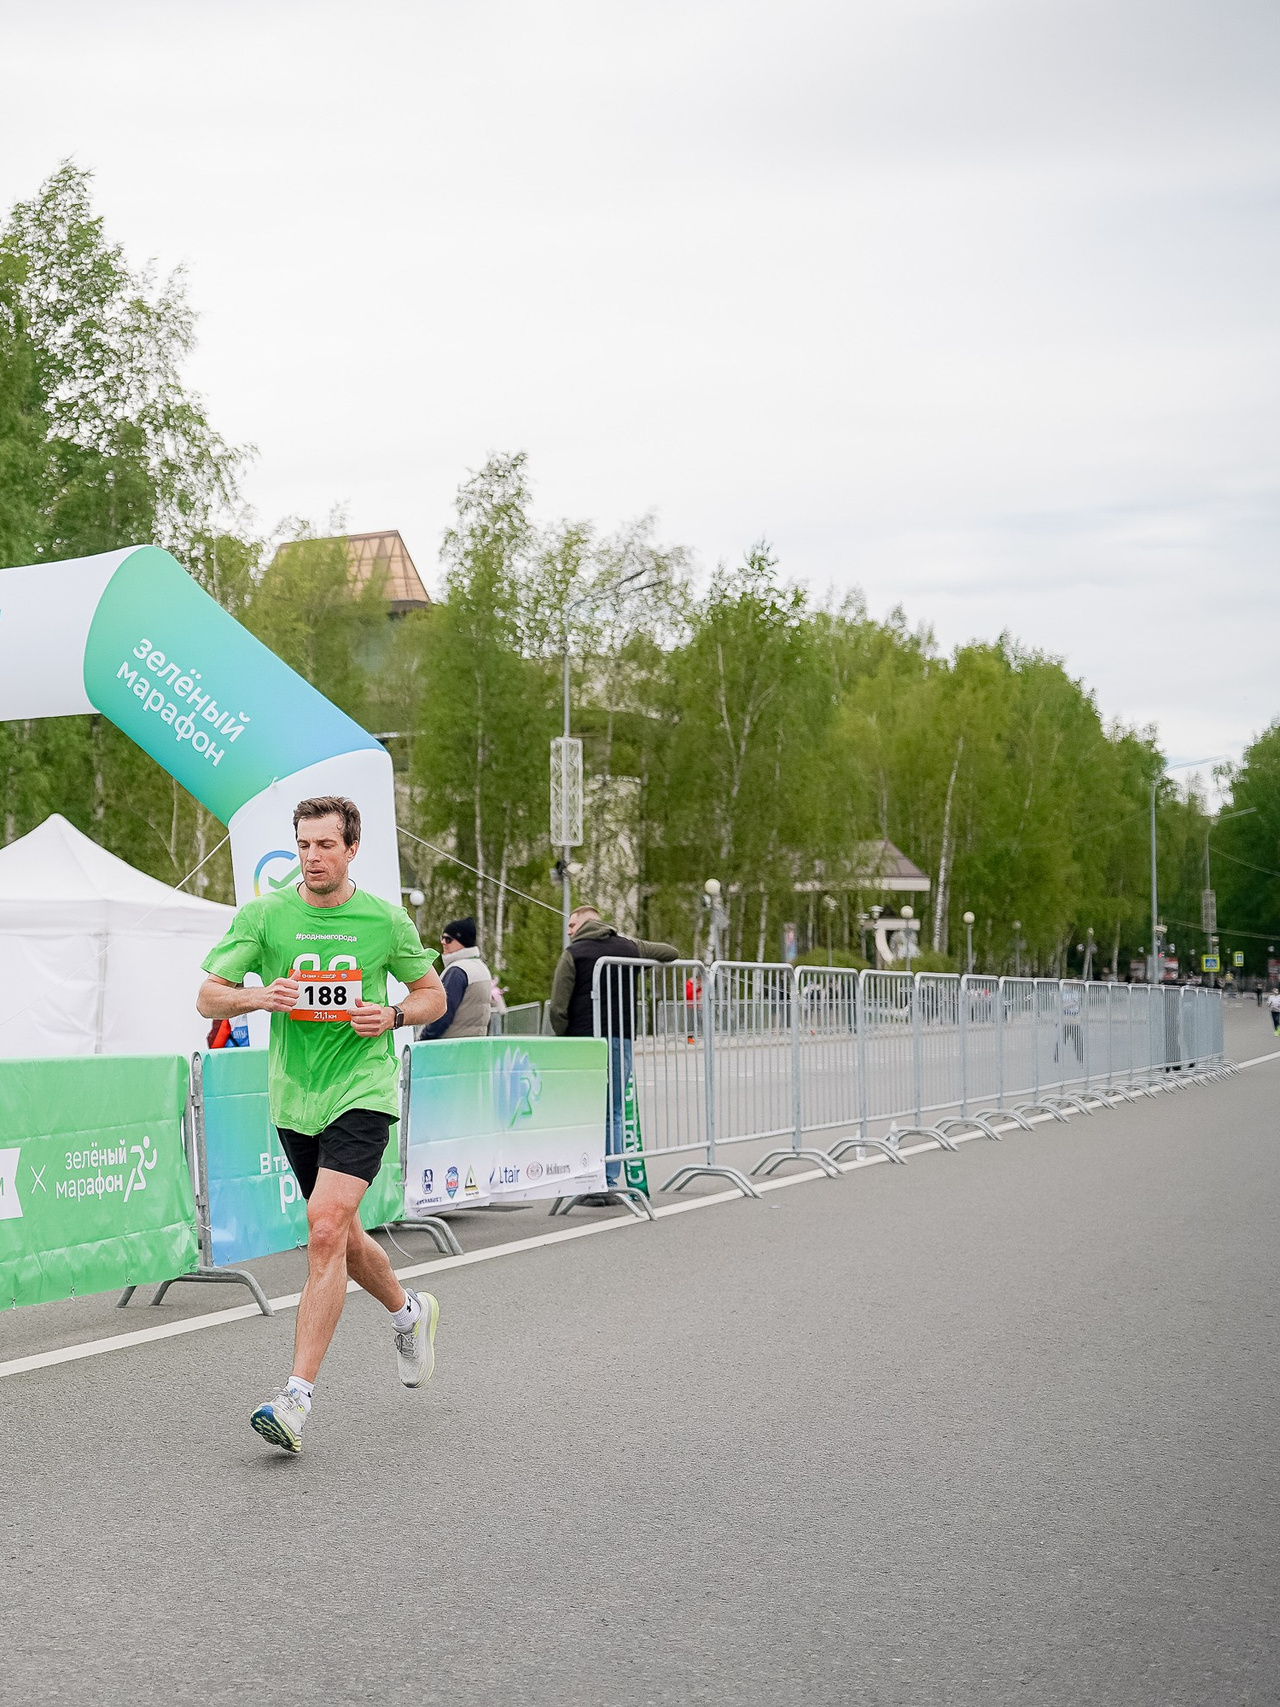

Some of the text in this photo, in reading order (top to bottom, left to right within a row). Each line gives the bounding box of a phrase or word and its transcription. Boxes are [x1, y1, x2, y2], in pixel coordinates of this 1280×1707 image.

[132, 638, 251, 743] зелёный
[116, 661, 225, 767] марафон
[295, 933, 357, 942] #родныегорода
[304, 985, 347, 1006] 188
[65, 1139, 127, 1171] зелёный
[55, 1168, 124, 1203] марафон
